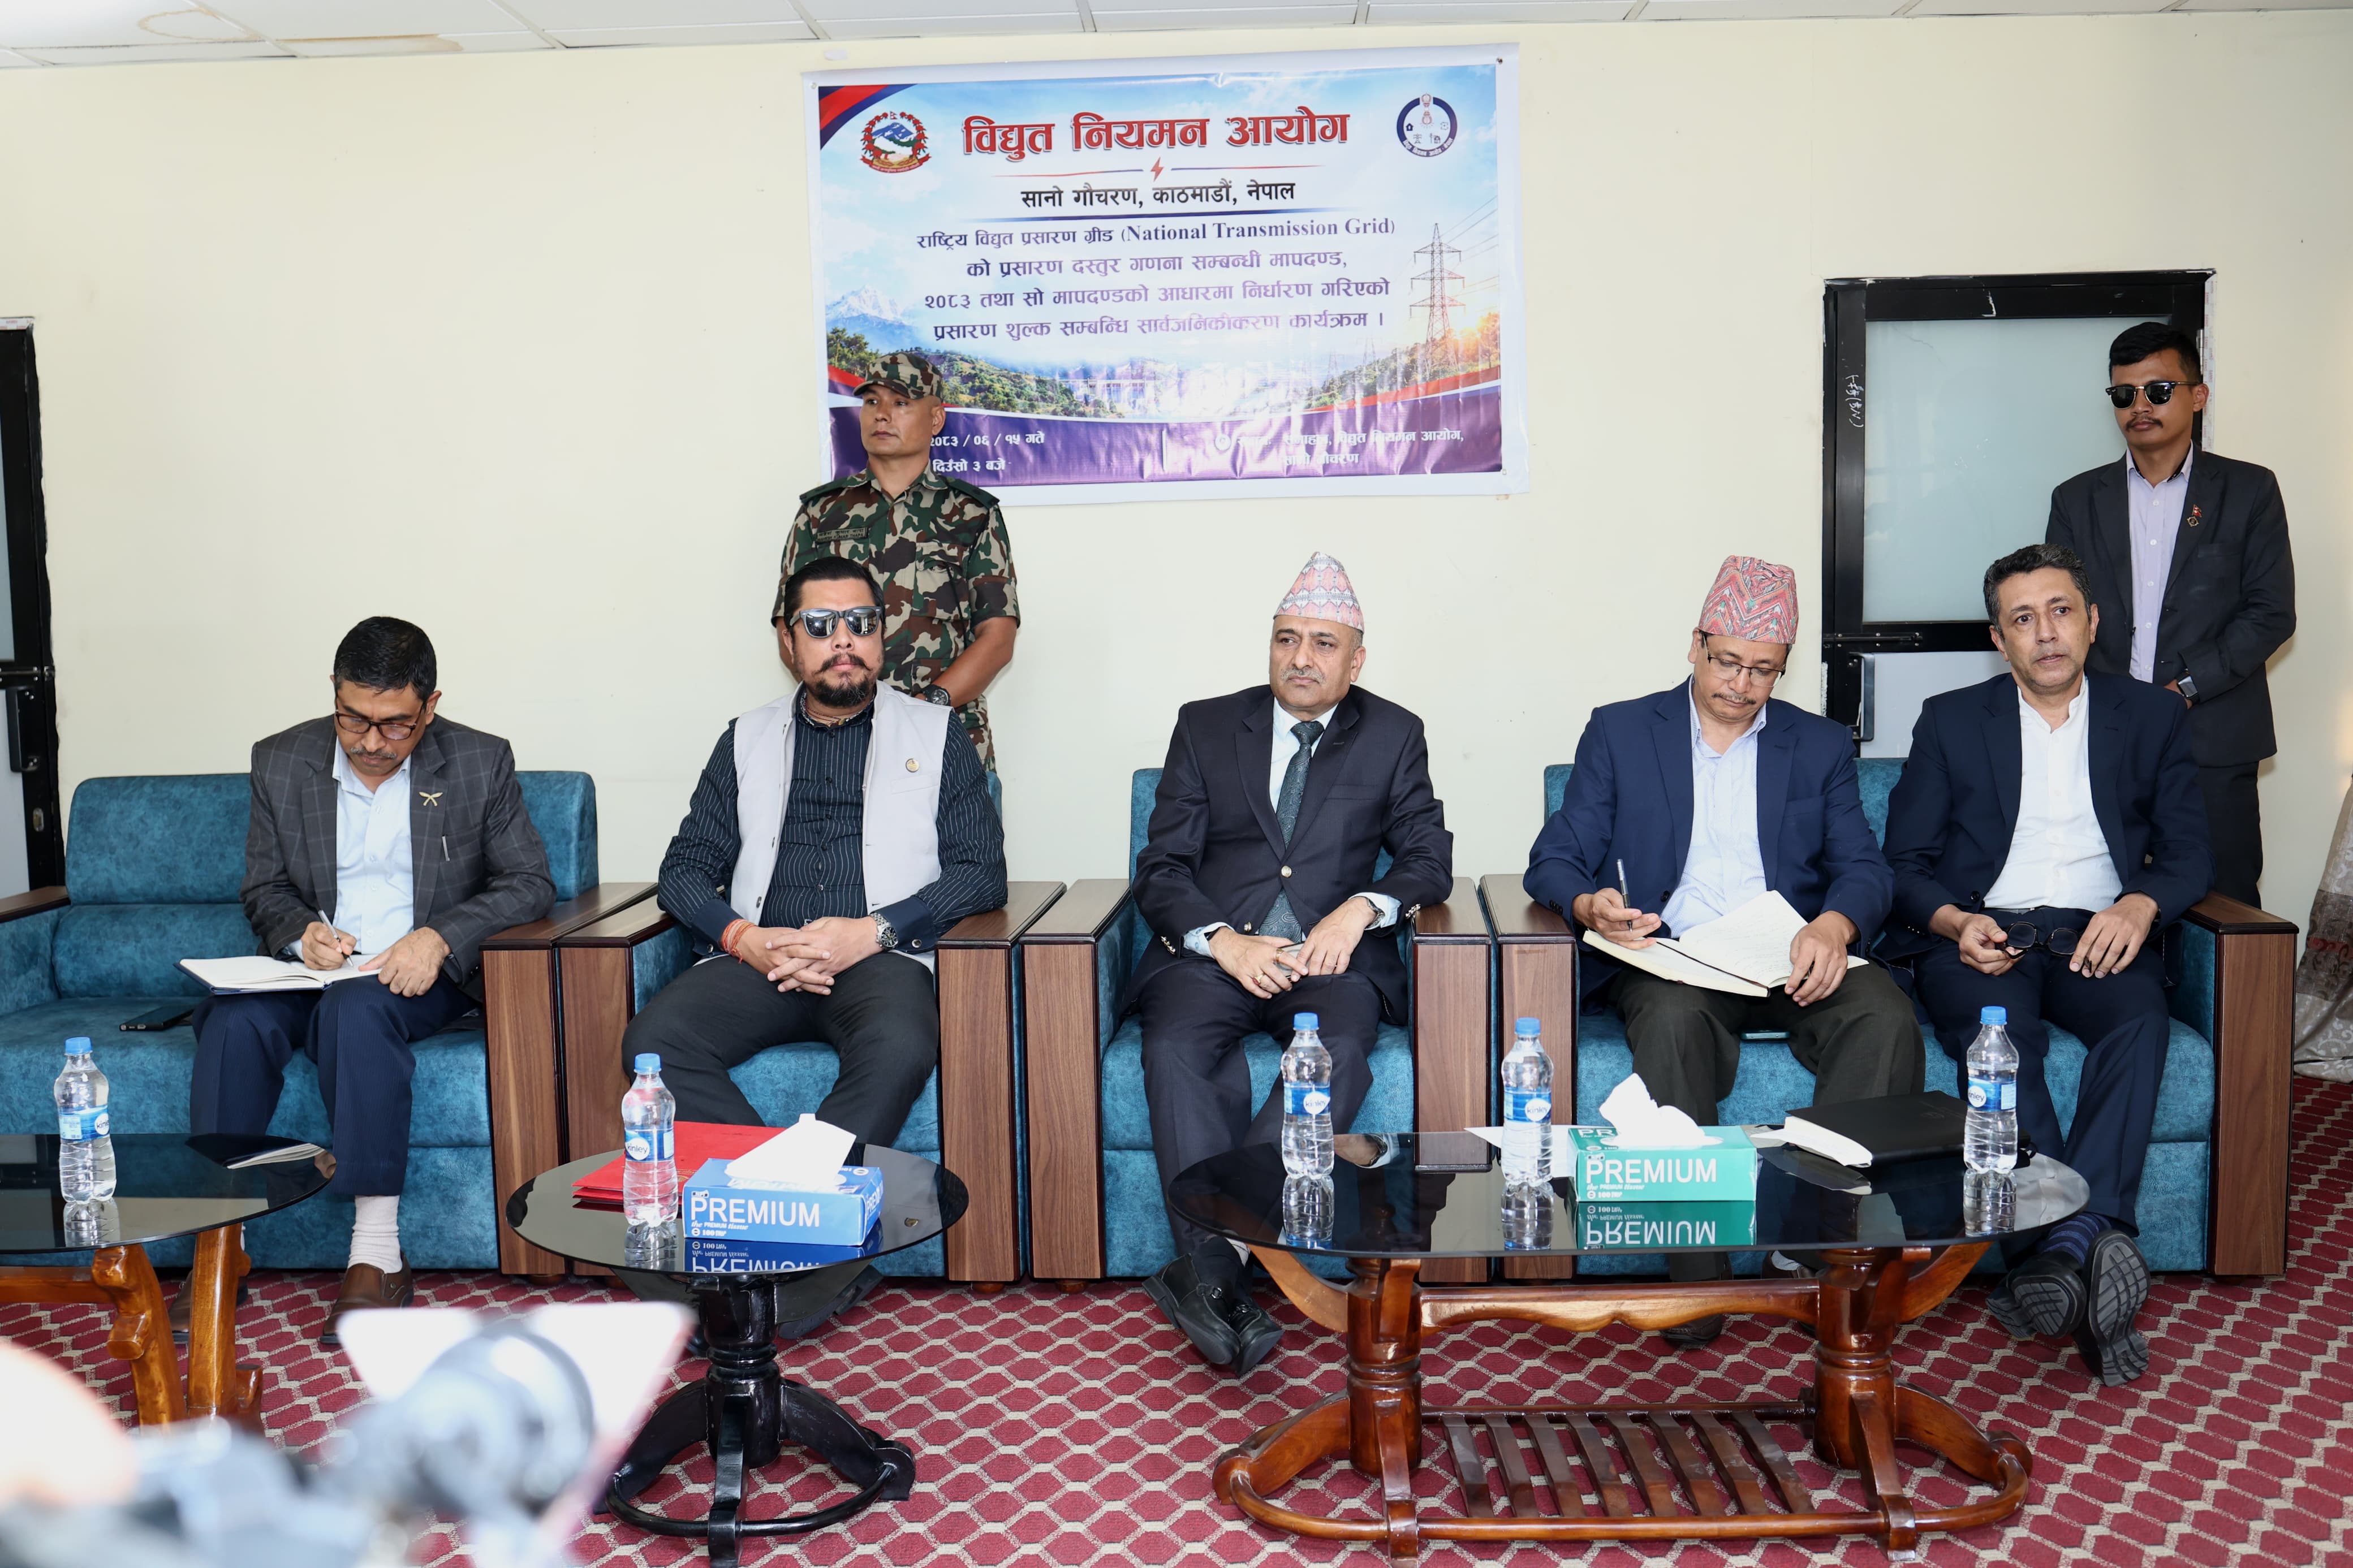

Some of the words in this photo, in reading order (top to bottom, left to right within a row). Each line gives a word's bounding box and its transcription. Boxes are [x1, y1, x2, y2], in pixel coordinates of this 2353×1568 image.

[963, 115, 1056, 162] विद्युत
[1071, 111, 1210, 151] नियमन
[1226, 106, 1351, 147] आयोग
[1020, 185, 1064, 208] सानो
[1072, 183, 1143, 209] गौचरण,
[1152, 178, 1238, 205] काठमाडौं,
[1247, 179, 1296, 200] नेपाल
[917, 231, 968, 250] राष्ट्रिय
[975, 230, 1014, 249] विद्युत
[1021, 231, 1078, 245] प्रसारण
[1084, 227, 1114, 244] ग्रीड
[1121, 223, 1207, 242] (National
[1213, 219, 1338, 239] Transmission
[1345, 218, 1395, 234] Grid)
[967, 258, 991, 277] को
[999, 260, 1063, 277] प्रसारण
[1072, 258, 1122, 277] दस्तुर
[1130, 257, 1183, 271] गणना
[1192, 250, 1261, 270] सम्बन्धी
[1269, 252, 1347, 267] मापदण्ड,
[925, 294, 971, 309] २०८३
[980, 292, 1015, 307] तथा
[1023, 287, 1044, 306] सो
[1053, 284, 1149, 305] मापदण्डको
[1158, 285, 1234, 302] आधारमा
[1243, 280, 1313, 299] निर्धारण
[1321, 277, 1390, 297] गरिएको
[933, 324, 997, 341] प्रसारण
[1006, 322, 1051, 341] शुल्क
[1059, 316, 1128, 336] सम्बन्धि
[1289, 309, 1368, 328] कार्यक्रम
[973, 435, 989, 446] ०६
[1025, 431, 1045, 444] गते
[1421, 428, 1464, 442] आयोग,
[973, 461, 981, 472] ३
[986, 457, 1006, 470] बजे
[627, 1143, 648, 1154] kinley
[1586, 1159, 1717, 1183] PREMIUM
[691, 1197, 820, 1228] PREMIUM
